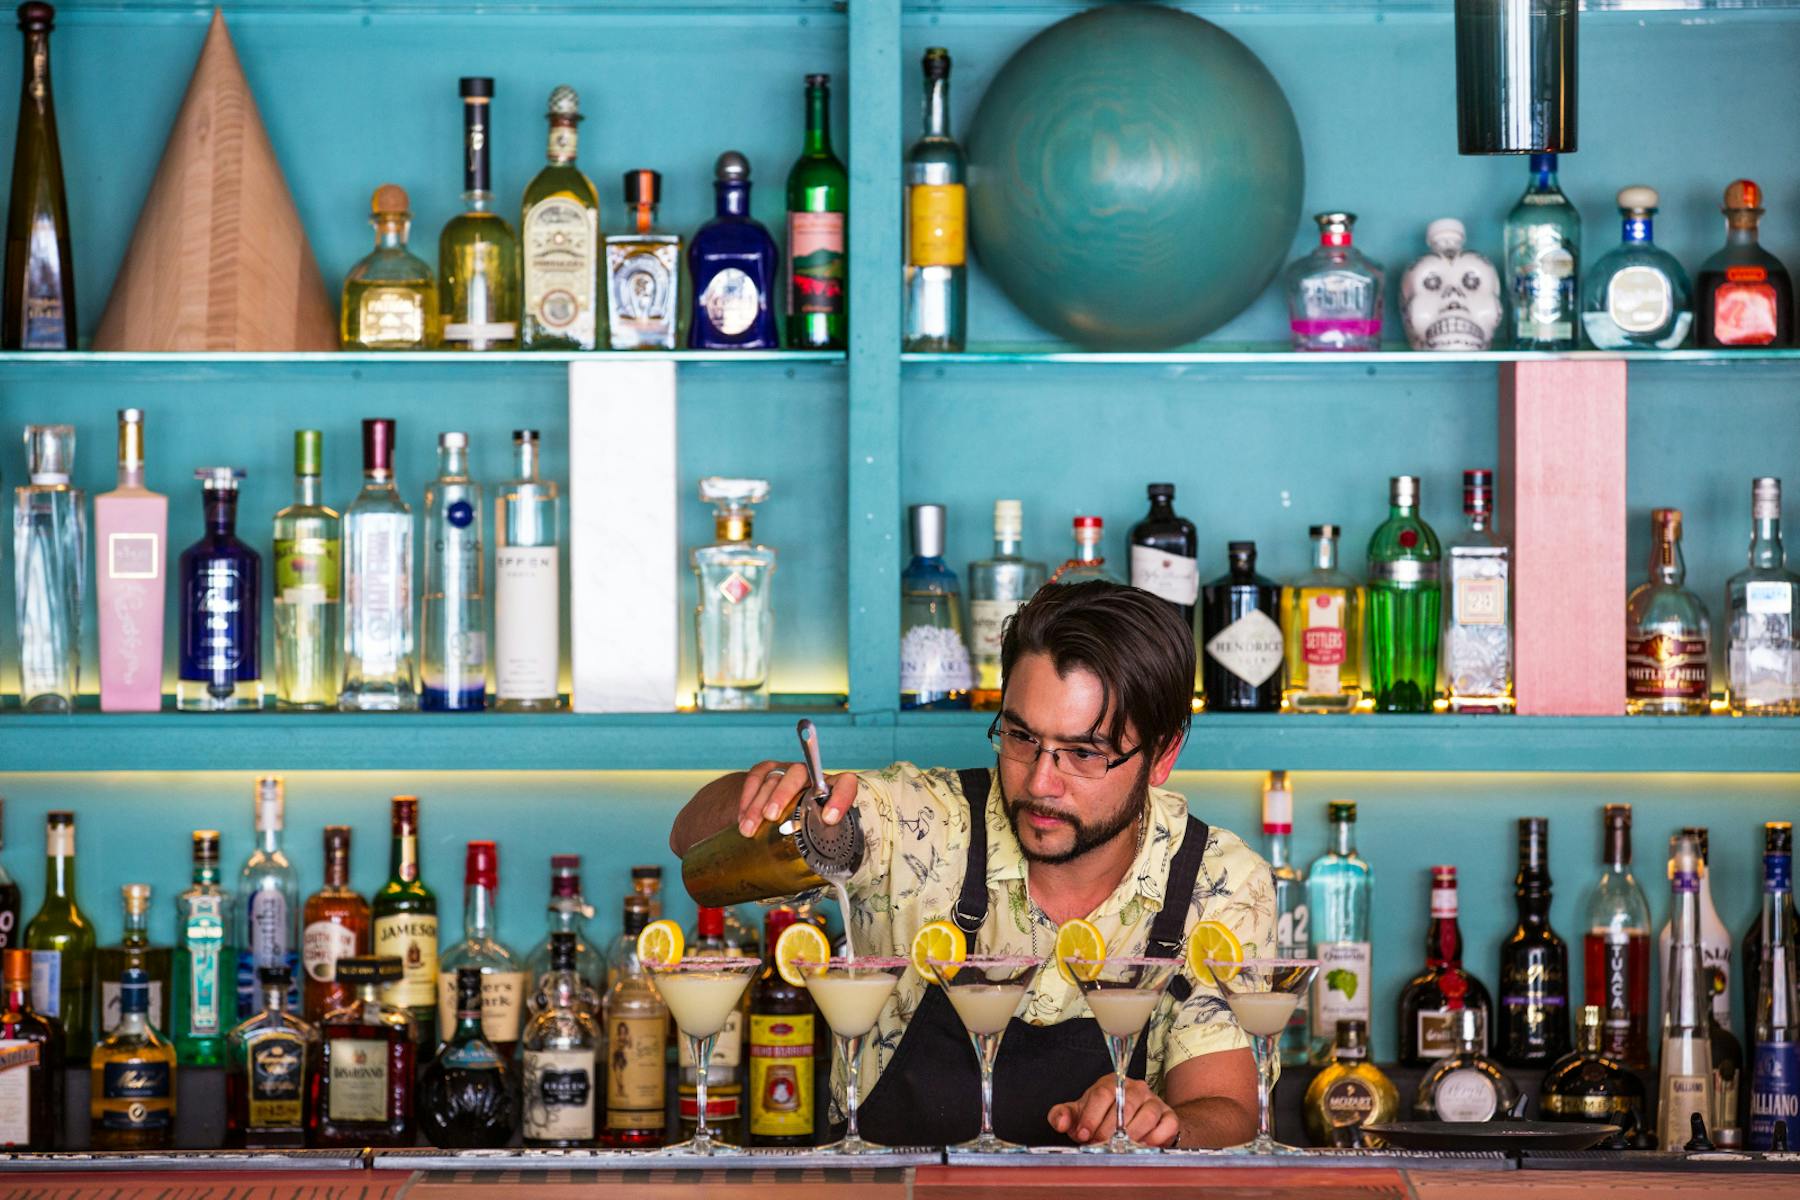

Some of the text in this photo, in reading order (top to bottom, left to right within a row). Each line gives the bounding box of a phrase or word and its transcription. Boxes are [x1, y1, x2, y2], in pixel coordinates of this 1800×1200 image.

[1611, 945, 1623, 1009] TUACA
[1330, 1096, 1371, 1106] MOZART
[1751, 1092, 1799, 1117] ALLIANO
